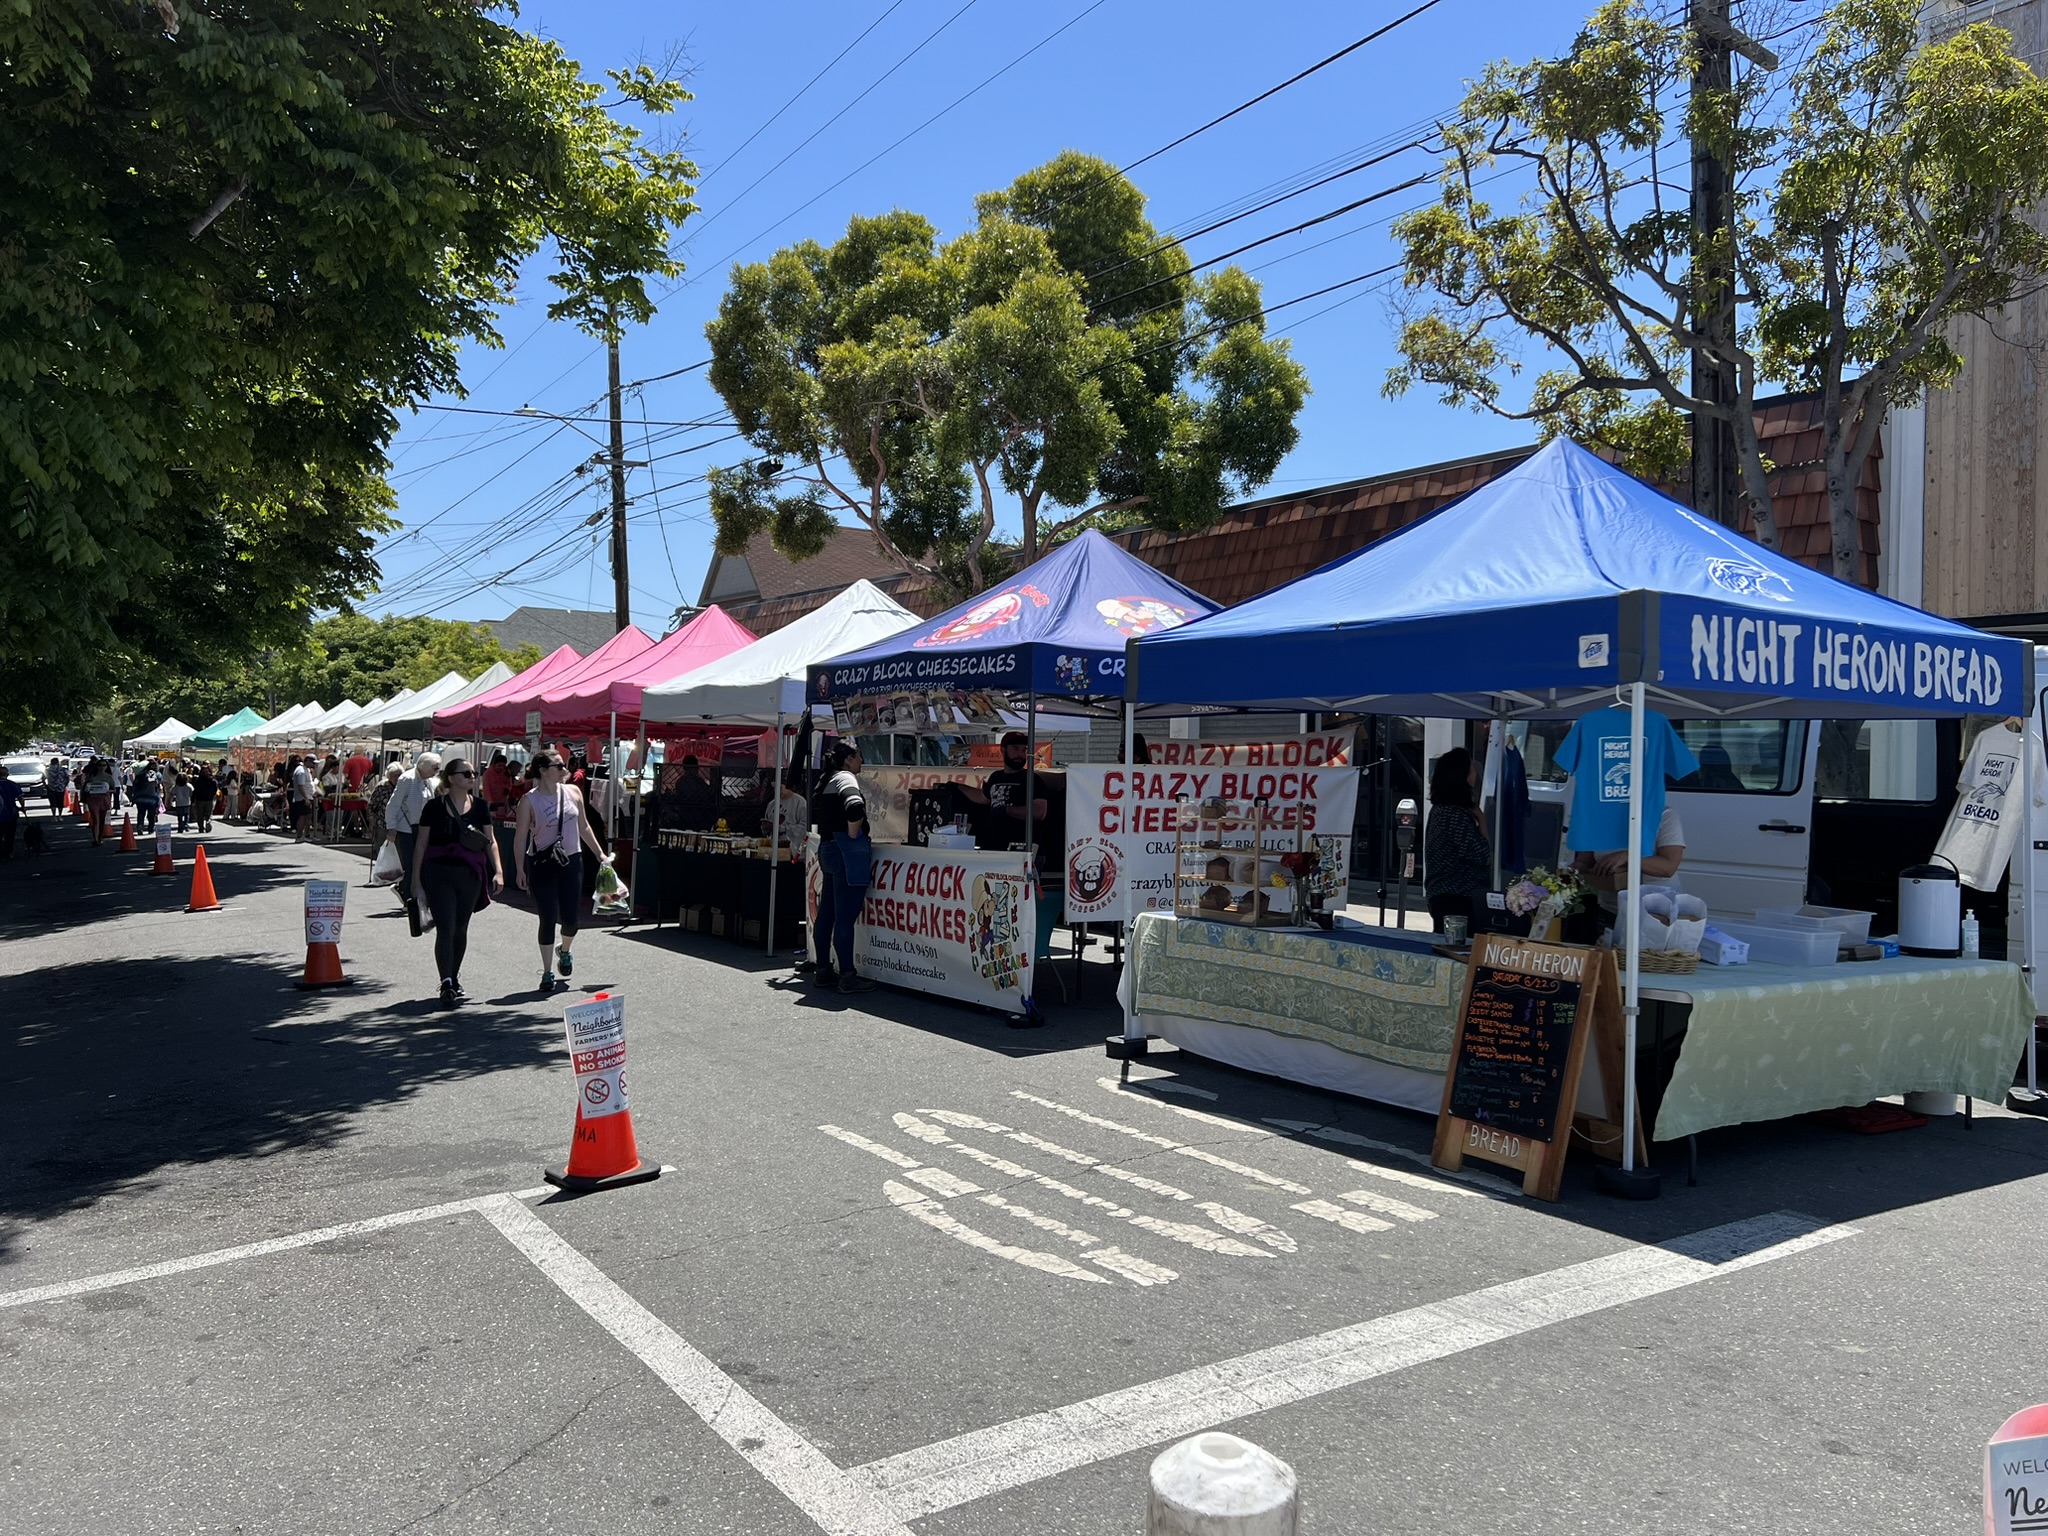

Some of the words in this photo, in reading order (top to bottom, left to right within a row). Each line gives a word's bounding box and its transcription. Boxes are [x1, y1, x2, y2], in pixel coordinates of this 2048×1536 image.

[834, 666, 870, 686] CRAZY
[873, 660, 914, 682] BLOCK
[917, 652, 1017, 677] CHEESECAKES
[1690, 614, 1802, 686] NIGHT
[1813, 625, 1907, 695] HERON
[1913, 641, 2003, 707] BREAD
[1247, 736, 1350, 768] BLOCK
[1604, 742, 1630, 751] NIGHT
[1604, 751, 1631, 759] HERON
[1984, 759, 2005, 769] NIGHT
[1102, 771, 1211, 800] CRAZY
[1219, 771, 1319, 801] BLOCK
[1605, 786, 1632, 798] BREA
[1963, 804, 2000, 821] BREAD
[870, 859, 905, 891] AZY
[905, 861, 967, 901] BLOCK
[857, 896, 967, 945] HEESECAKES
[869, 935, 902, 954] Alameda,
[904, 941, 916, 955] CA
[916, 944, 938, 959] 94501
[862, 953, 946, 981] @crazyblockcheesecakes
[981, 953, 1029, 978] CHEESECAKE
[1484, 944, 1530, 966] NIGHT
[1532, 949, 1584, 977] HERON
[570, 1007, 604, 1020] WELCOME
[612, 1002, 622, 1010] OUR
[575, 1034, 609, 1046] FARMERS'
[577, 1052, 594, 1063] NO
[596, 1043, 625, 1059] ANIMALS
[579, 1062, 596, 1072] NO
[597, 1054, 626, 1069] SMOKIN
[1469, 1124, 1520, 1158] BREAD
